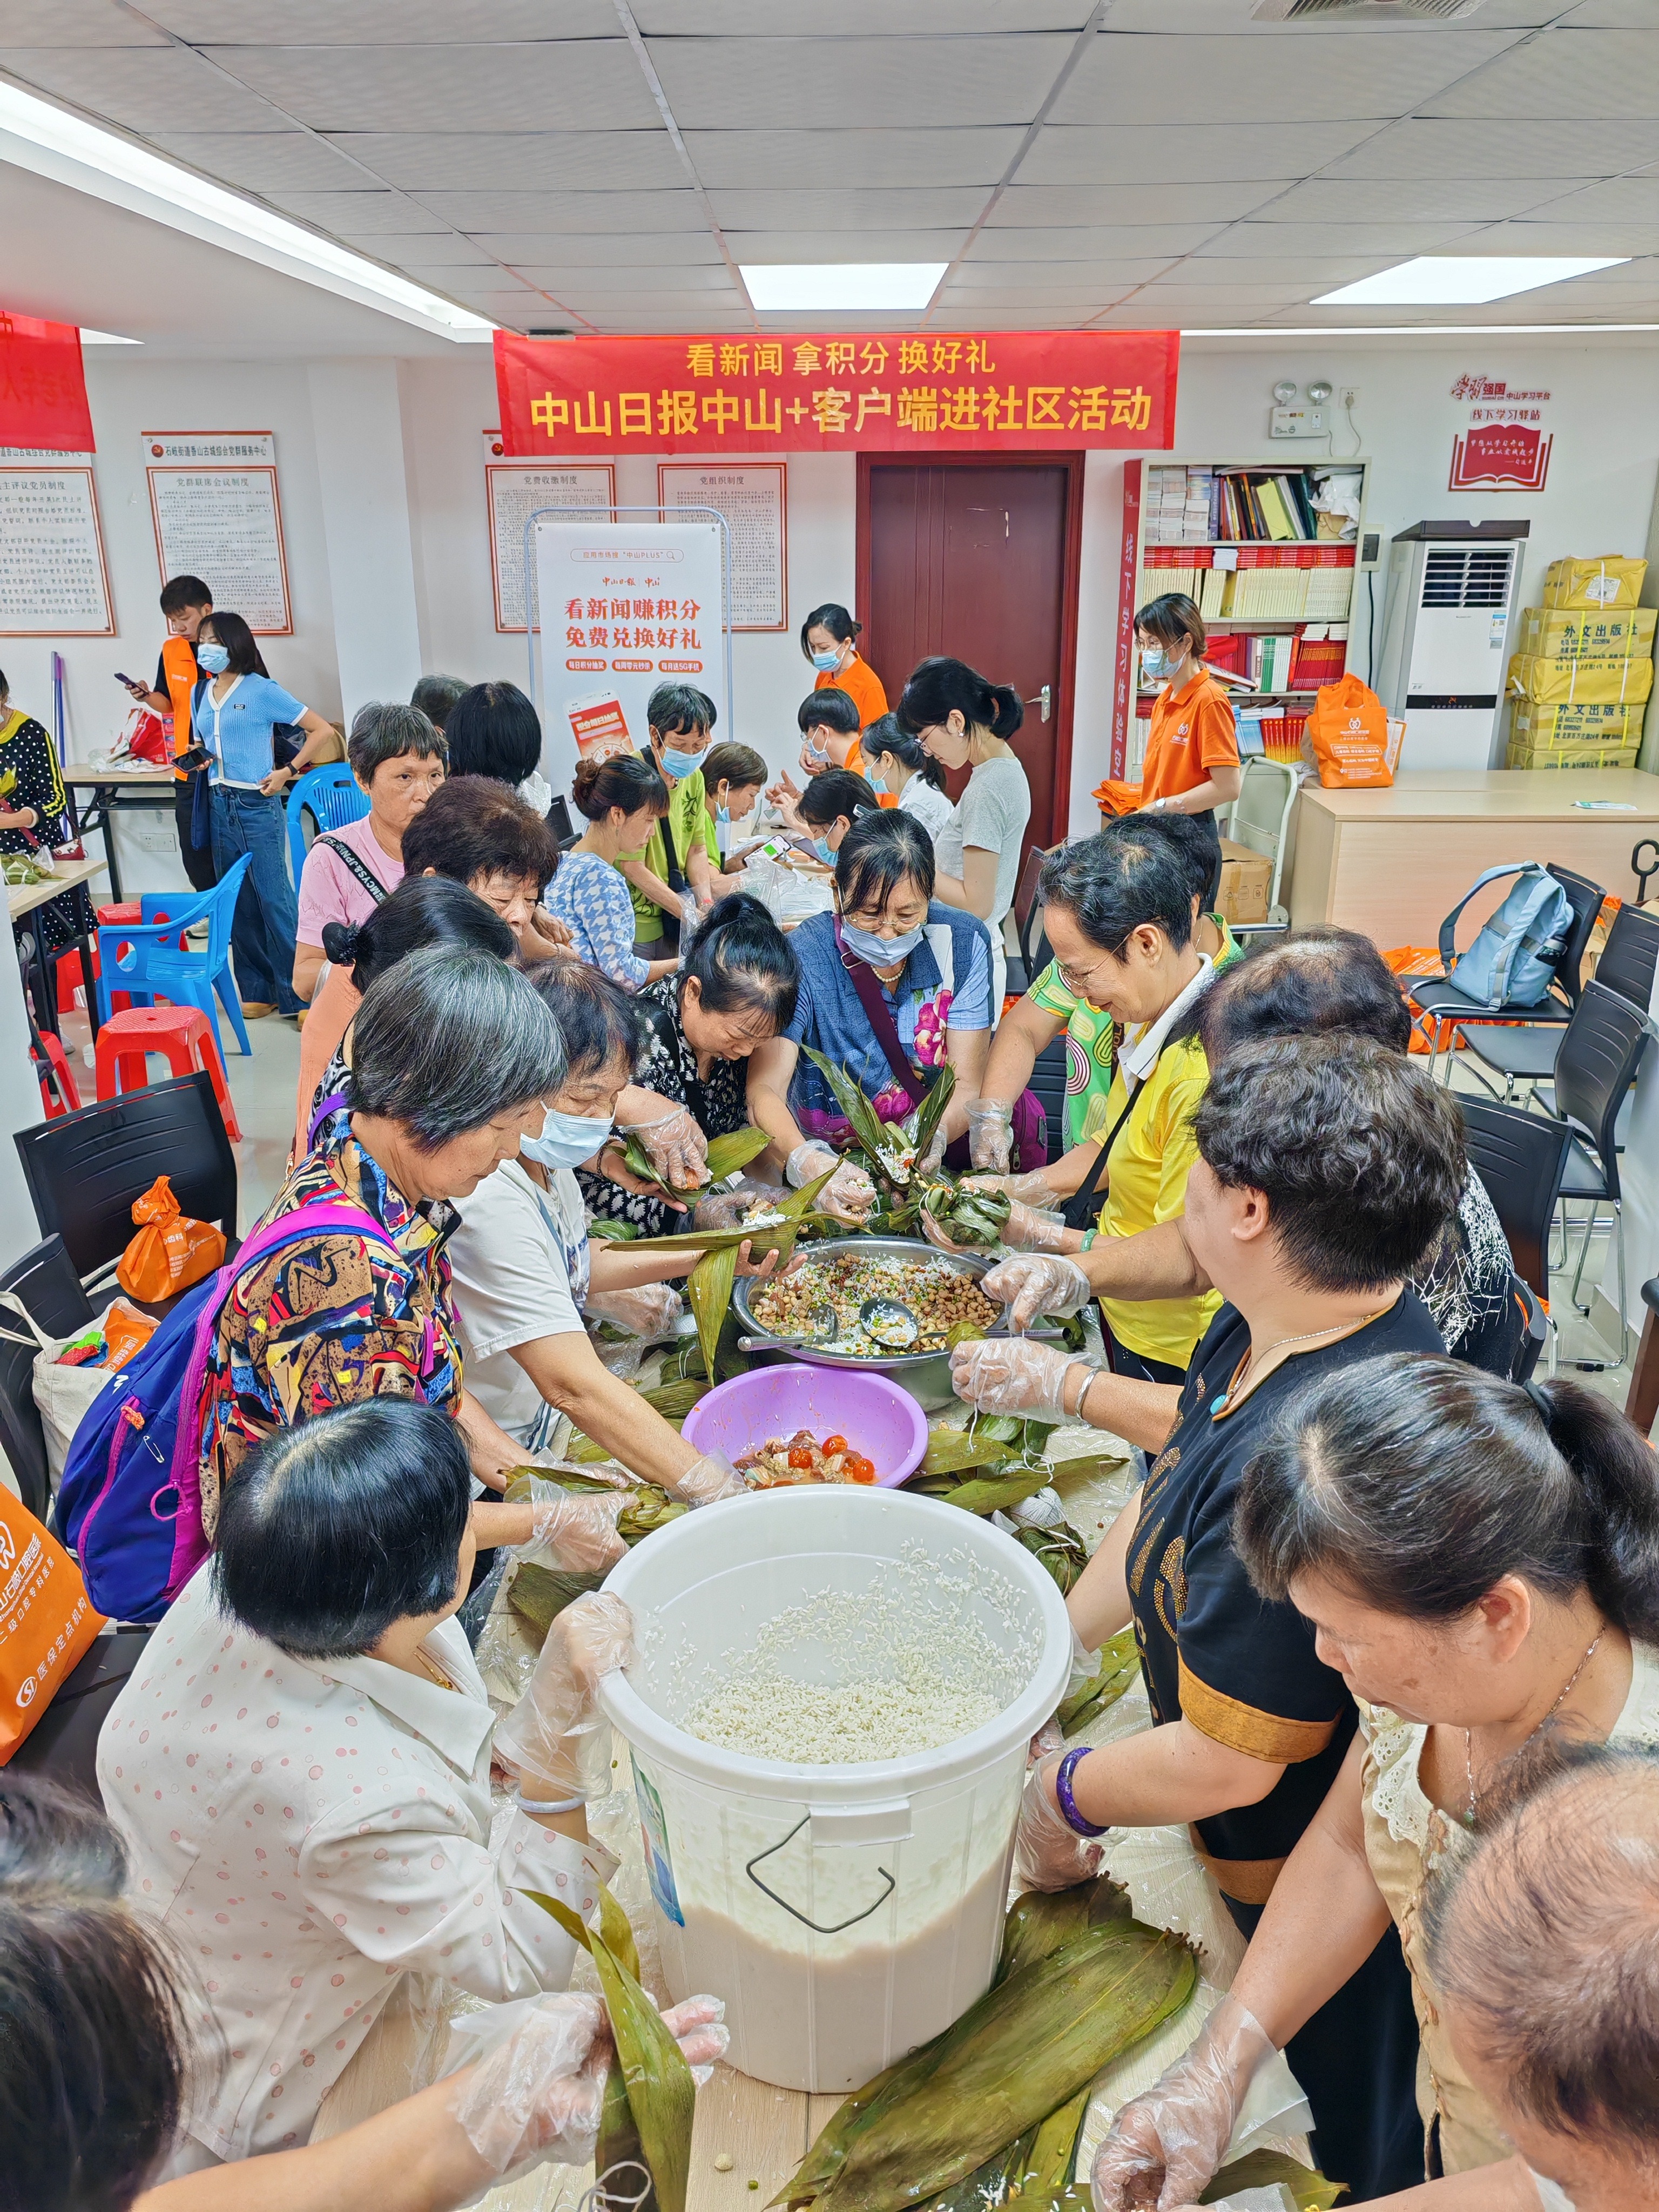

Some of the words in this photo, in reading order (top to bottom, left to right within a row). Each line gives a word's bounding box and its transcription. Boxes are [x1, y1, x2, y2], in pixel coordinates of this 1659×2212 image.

[686, 342, 783, 377] 看新闻
[792, 340, 889, 376] 拿积分
[899, 340, 996, 375] 换好礼
[1506, 392, 1550, 400] 中山学习平台
[530, 386, 1151, 437] 中山日报中山+客户端进社区活动
[699, 476, 745, 485] 党组织制度
[564, 597, 702, 621] 看新闻赚积分
[565, 625, 702, 650] 免费兑换好礼
[1563, 623, 1638, 638] 外文出版社
[37, 1596, 87, 1681] 医保定点机构
